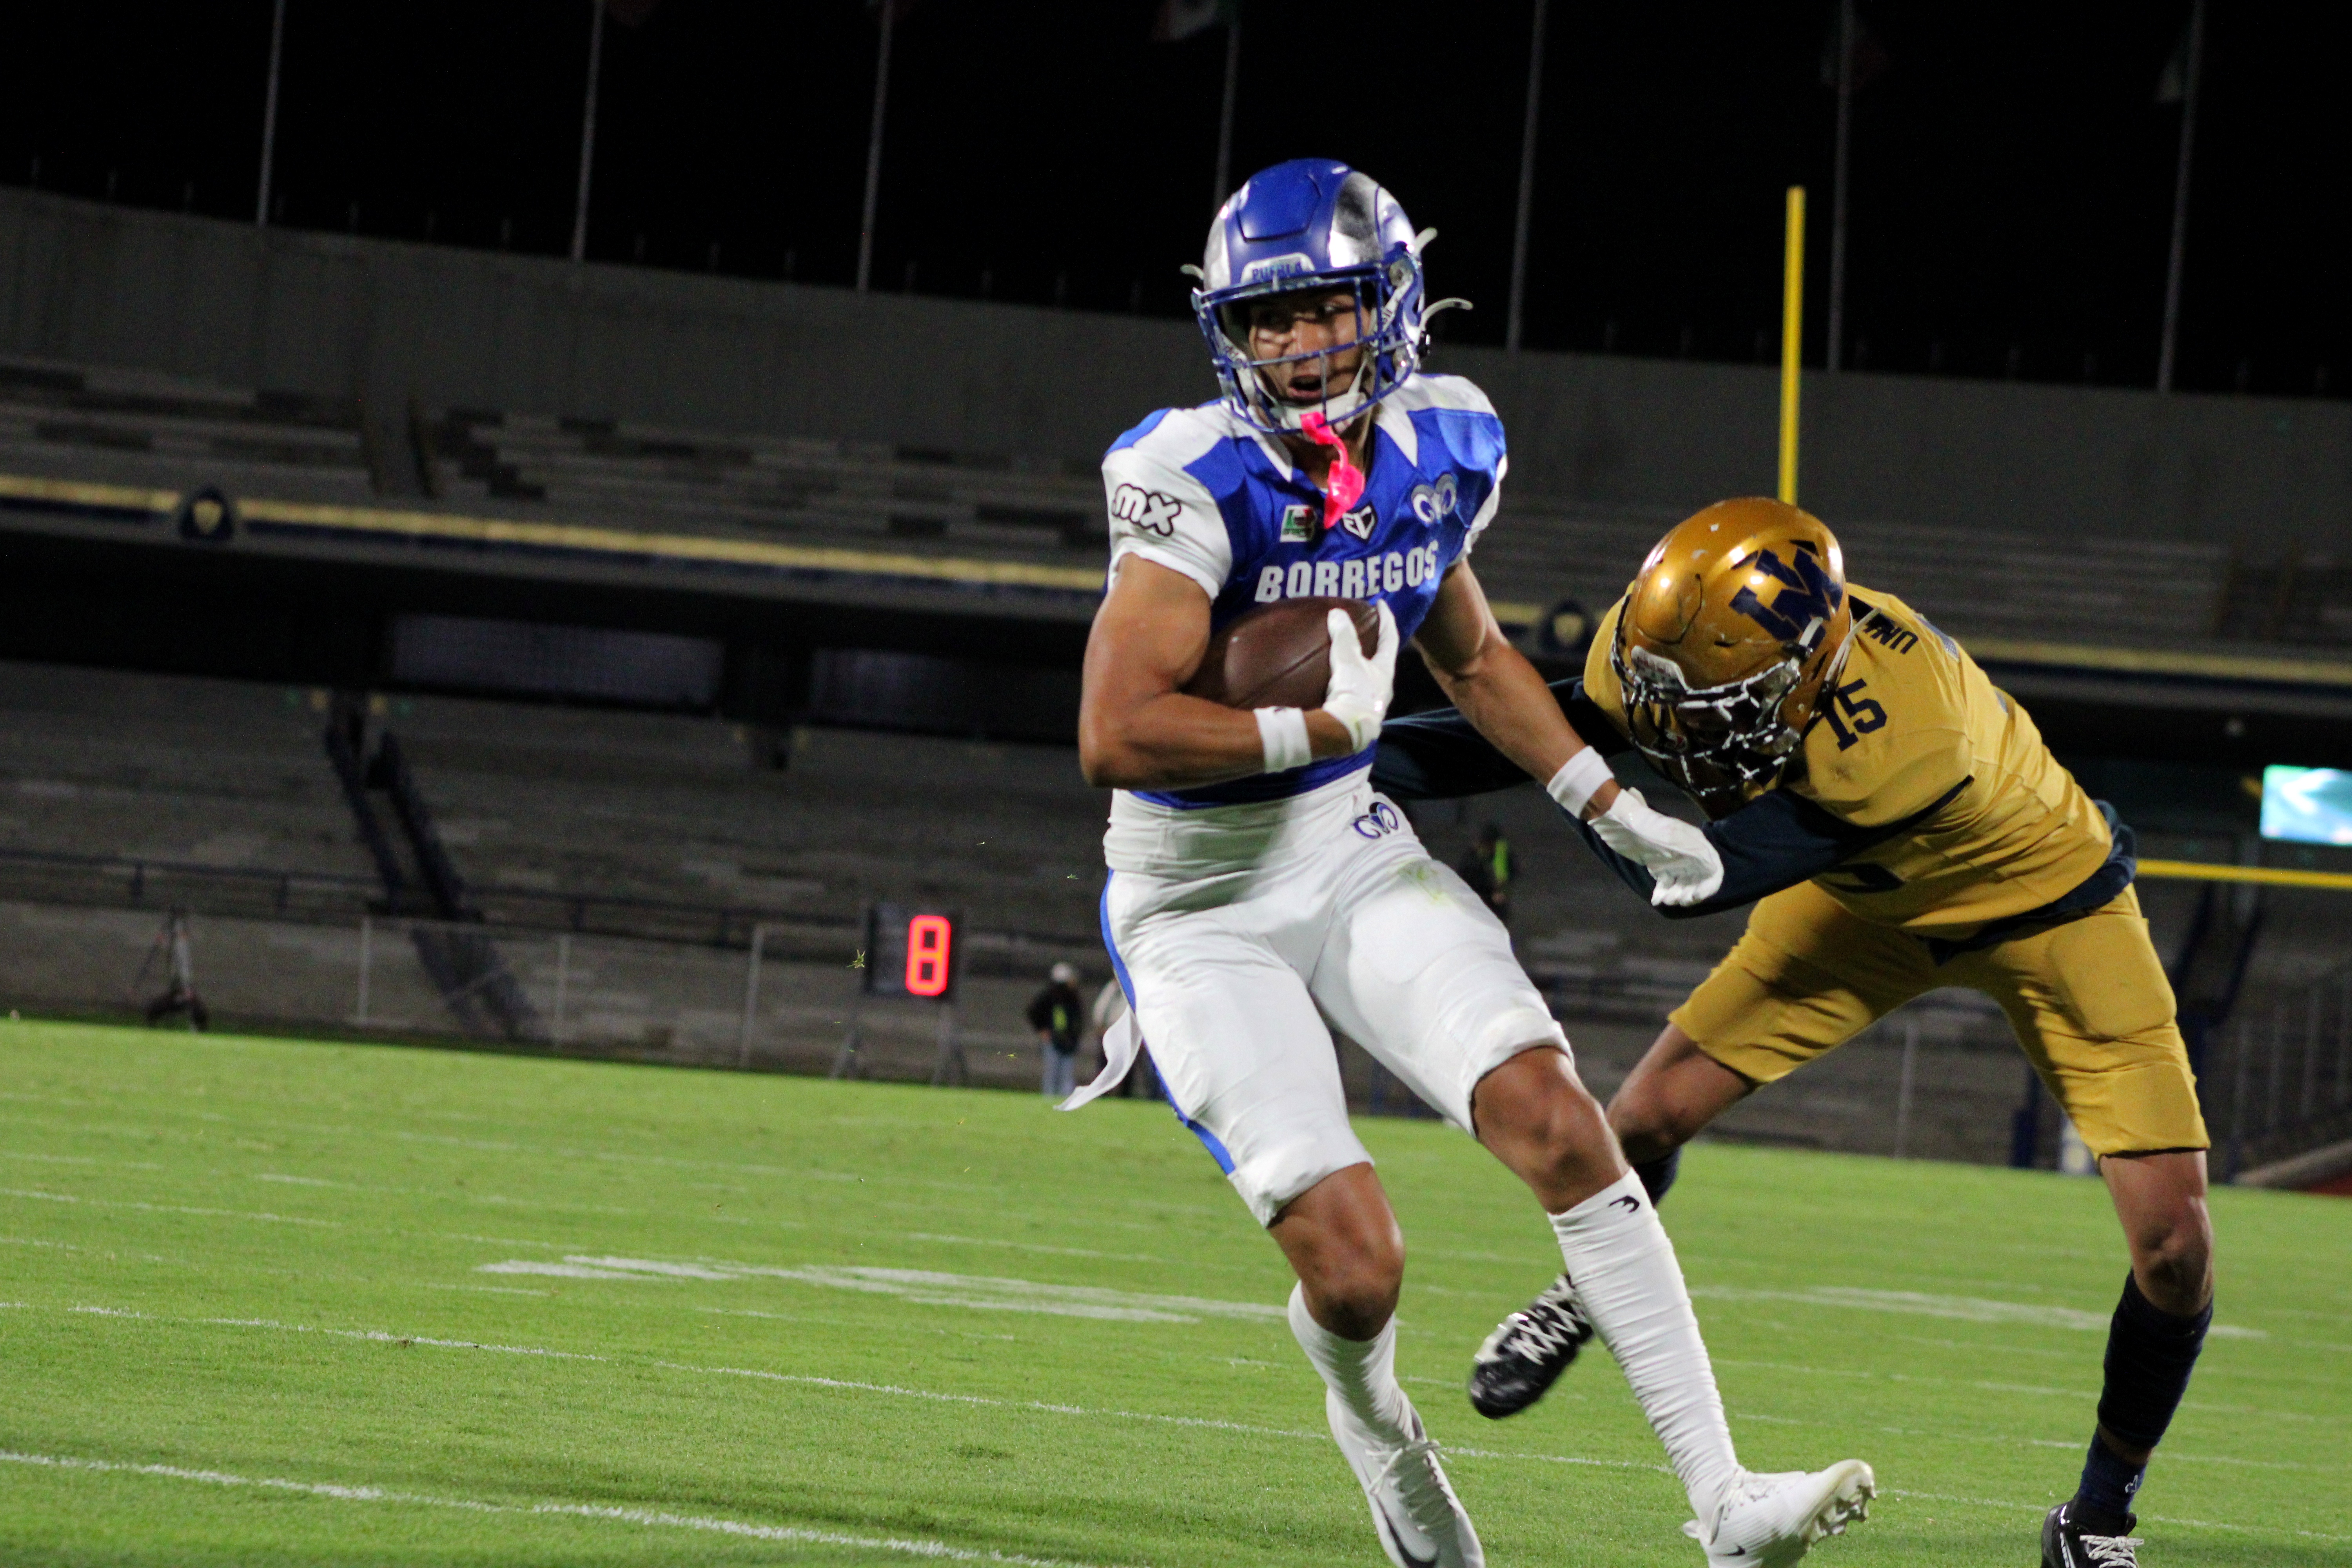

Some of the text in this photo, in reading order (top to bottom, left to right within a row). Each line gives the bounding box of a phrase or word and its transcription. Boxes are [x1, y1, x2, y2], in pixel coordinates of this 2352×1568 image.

[1254, 539, 1439, 603] BORREGOS
[1824, 678, 1887, 752] 15
[906, 915, 952, 996] 8
